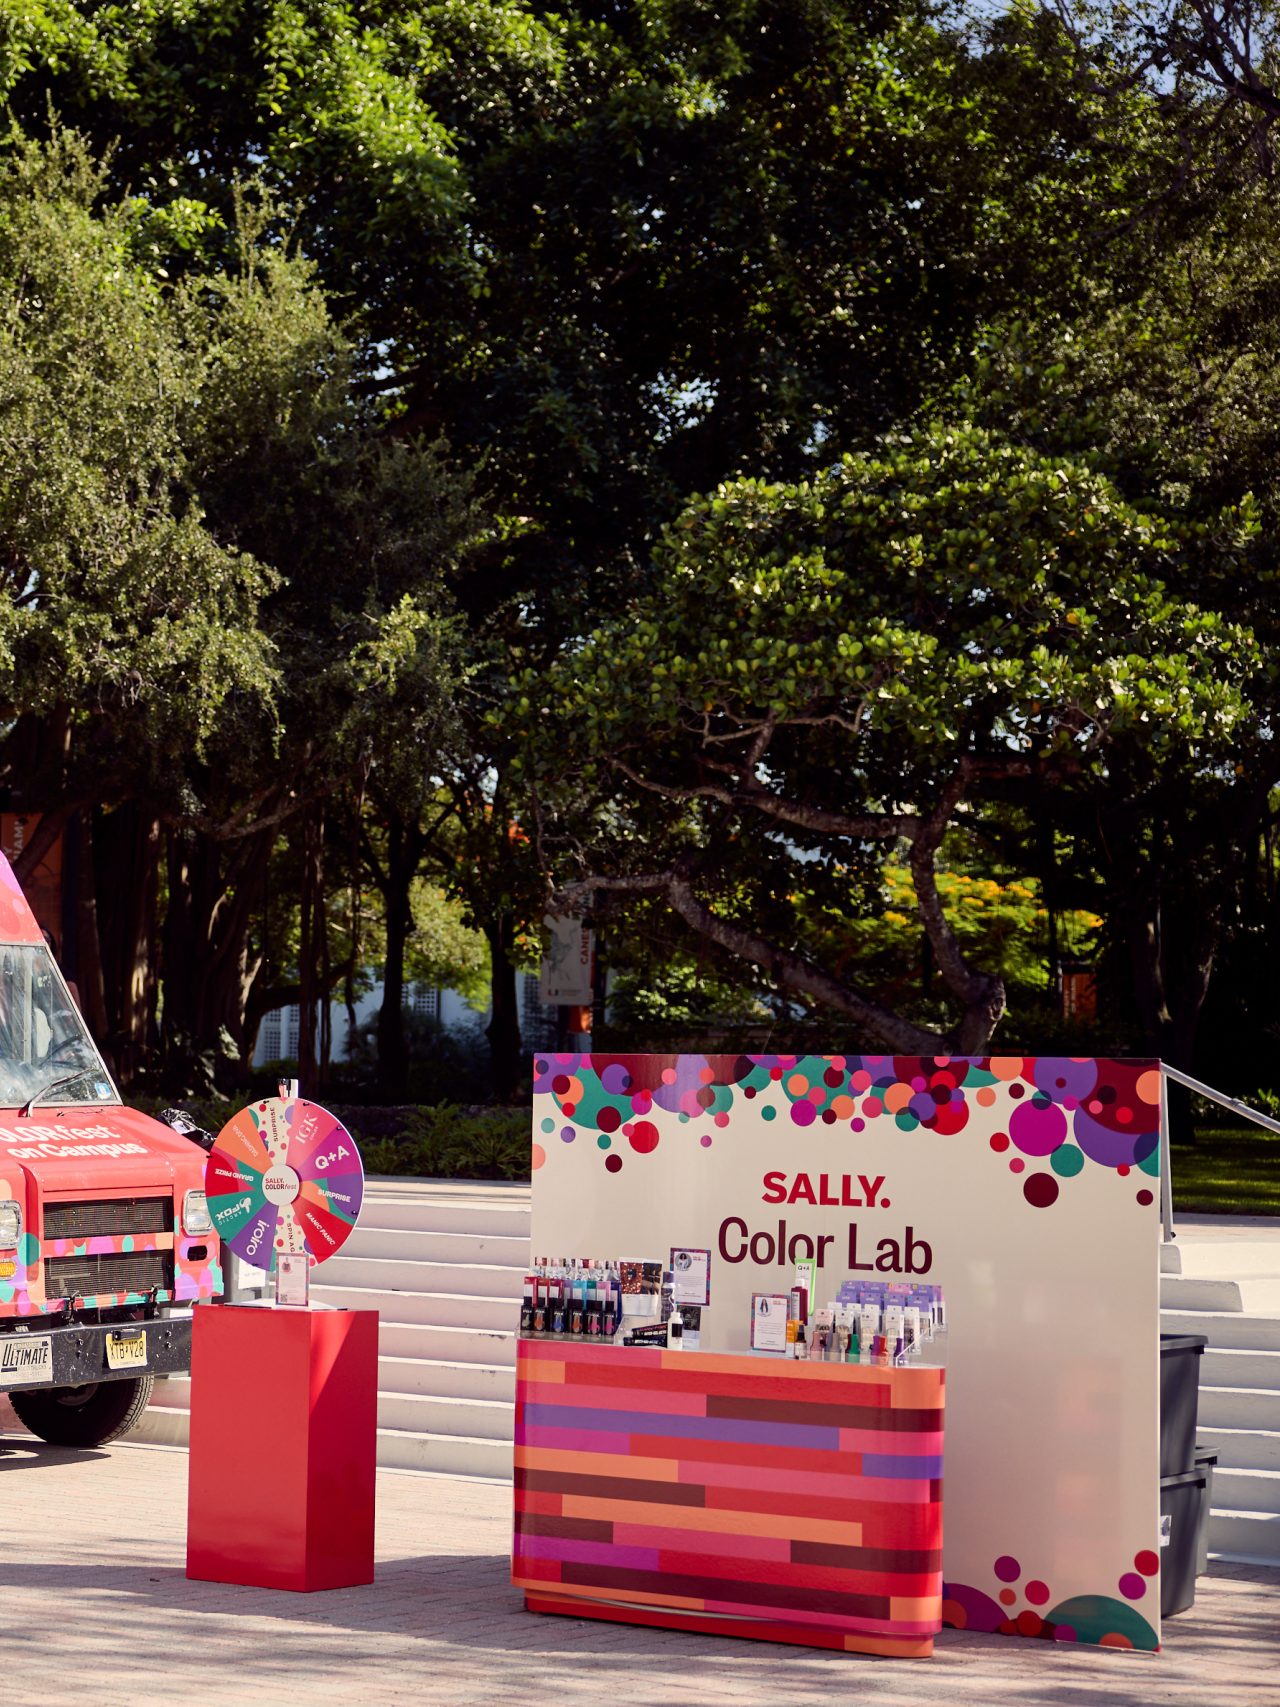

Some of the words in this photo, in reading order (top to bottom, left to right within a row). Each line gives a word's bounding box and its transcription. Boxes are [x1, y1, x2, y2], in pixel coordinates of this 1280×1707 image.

[270, 1107, 278, 1142] SURPRISE
[295, 1112, 318, 1144] IGK
[7, 1147, 48, 1159] on
[38, 1142, 149, 1158] Campus
[315, 1145, 350, 1170] Q+A
[215, 1168, 232, 1178] PRIZE
[233, 1172, 254, 1182] GRAND
[317, 1188, 352, 1203] SURPRISE
[761, 1171, 891, 1209] SALLY.
[215, 1203, 241, 1221] FOX
[246, 1219, 270, 1256] iroiro
[286, 1222, 294, 1240] SPIN
[305, 1212, 323, 1230] MANIC
[319, 1228, 336, 1246] PANIC
[718, 1216, 835, 1268] Color
[848, 1222, 933, 1275] Lab
[2, 1343, 48, 1367] ULTIMATE
